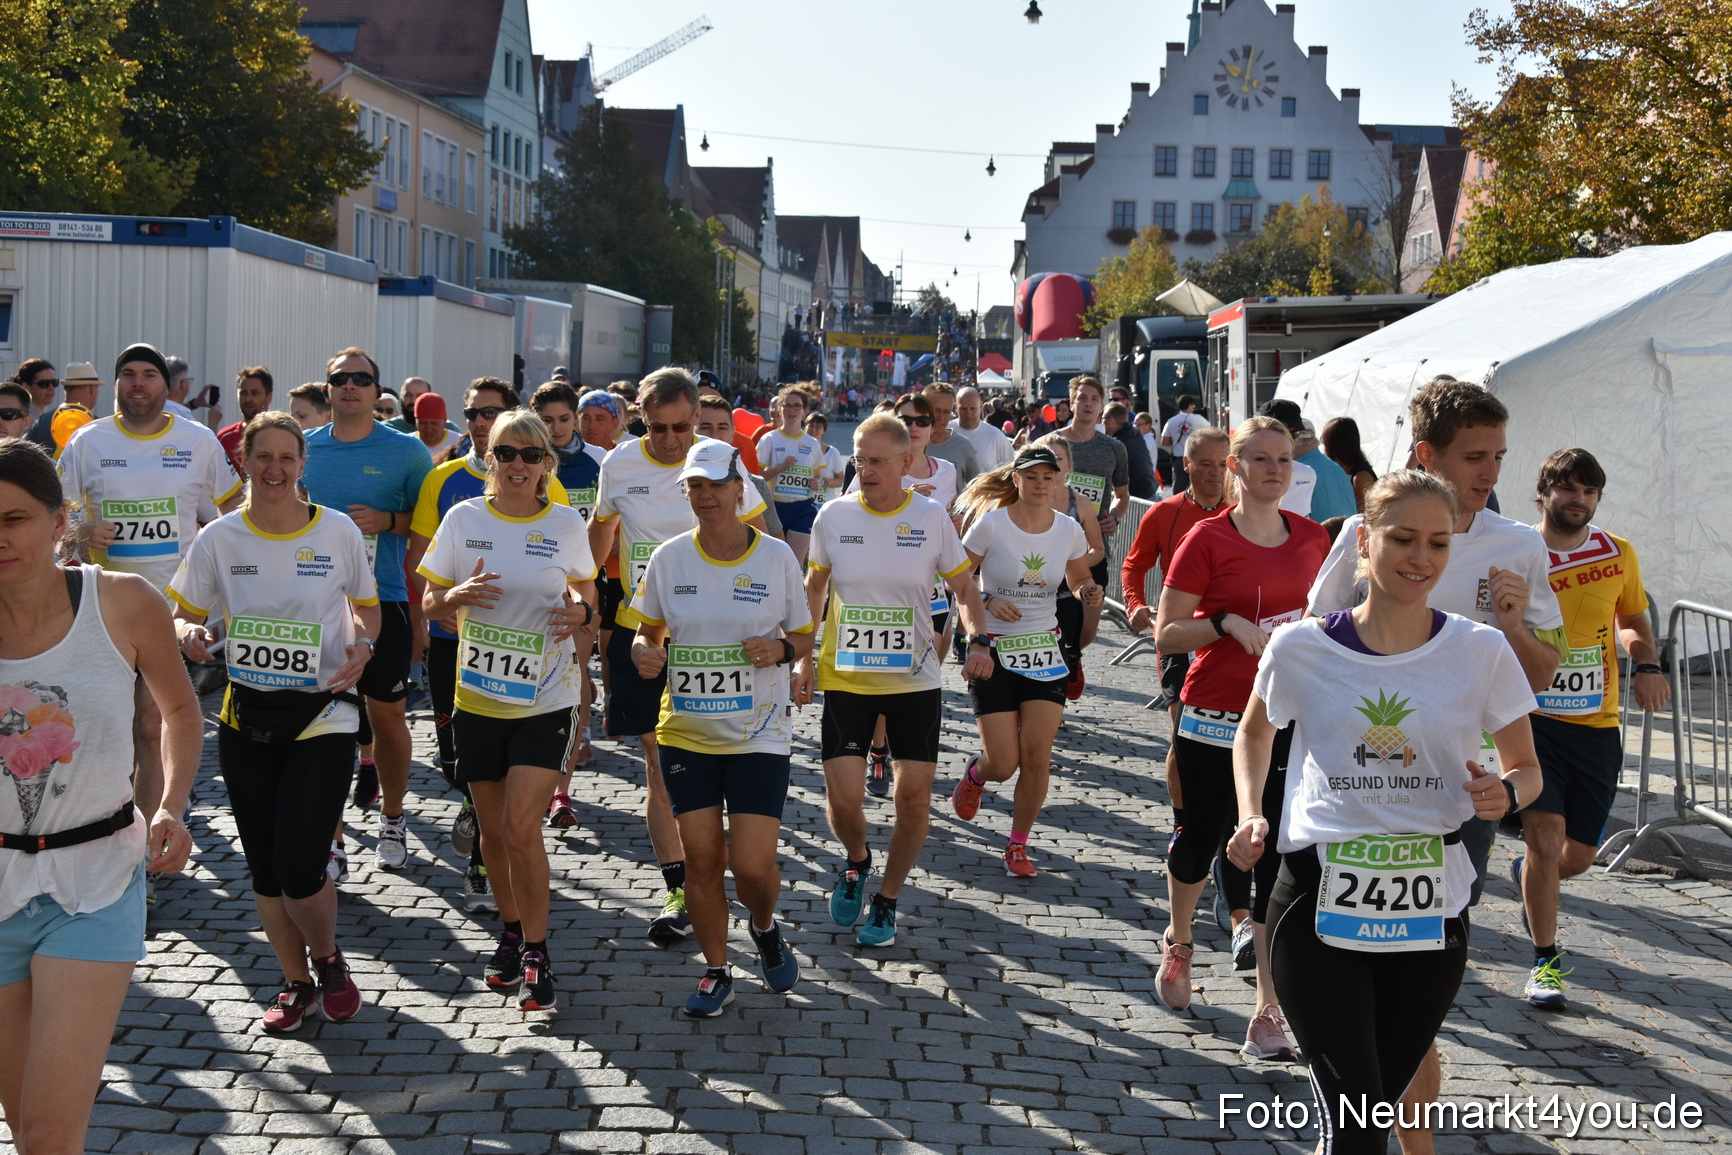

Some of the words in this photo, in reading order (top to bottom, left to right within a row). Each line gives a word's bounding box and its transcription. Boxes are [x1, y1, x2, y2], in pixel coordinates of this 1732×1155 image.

[58, 223, 77, 231] 08141
[862, 336, 900, 347] START
[779, 475, 808, 487] 2060
[108, 499, 171, 516] BOCK
[112, 520, 172, 540] 2740
[897, 526, 910, 535] 20
[466, 540, 493, 548] BOCK
[527, 534, 543, 543] 20
[525, 550, 553, 559] Stadtlauf
[526, 544, 560, 553] Neumarkter
[297, 551, 314, 561] 20
[297, 570, 328, 578] Stadtlauf
[1576, 564, 1624, 586] BÖGL
[735, 577, 750, 588] 20
[732, 595, 762, 604] Stadtlauf
[733, 588, 770, 598] Neumarkter
[997, 587, 1029, 598] GESUND
[1030, 591, 1046, 599] UND
[845, 608, 909, 624] BOCK
[234, 619, 314, 643] BOCK
[466, 622, 538, 652] BOCK
[846, 628, 906, 650] 2113
[1001, 633, 1051, 651] BOCK
[236, 643, 309, 673] 2098
[467, 646, 531, 680] 2114
[674, 647, 746, 665] BOCK
[862, 655, 888, 665] UWE
[1006, 651, 1053, 669] 2347
[239, 671, 305, 686] SUSANNE
[677, 671, 740, 694] 2121
[1544, 671, 1595, 692] 401
[481, 679, 507, 693] LISA
[684, 700, 739, 711] CLAUDIA
[1544, 698, 1588, 707] MARCO
[1329, 776, 1383, 790] GESUND
[1388, 776, 1420, 790] UND
[1362, 794, 1382, 804] mit
[1385, 794, 1410, 805] Julia
[1336, 838, 1435, 865] BOCK
[1334, 872, 1434, 911] 2420
[1356, 923, 1408, 938] ANJA
